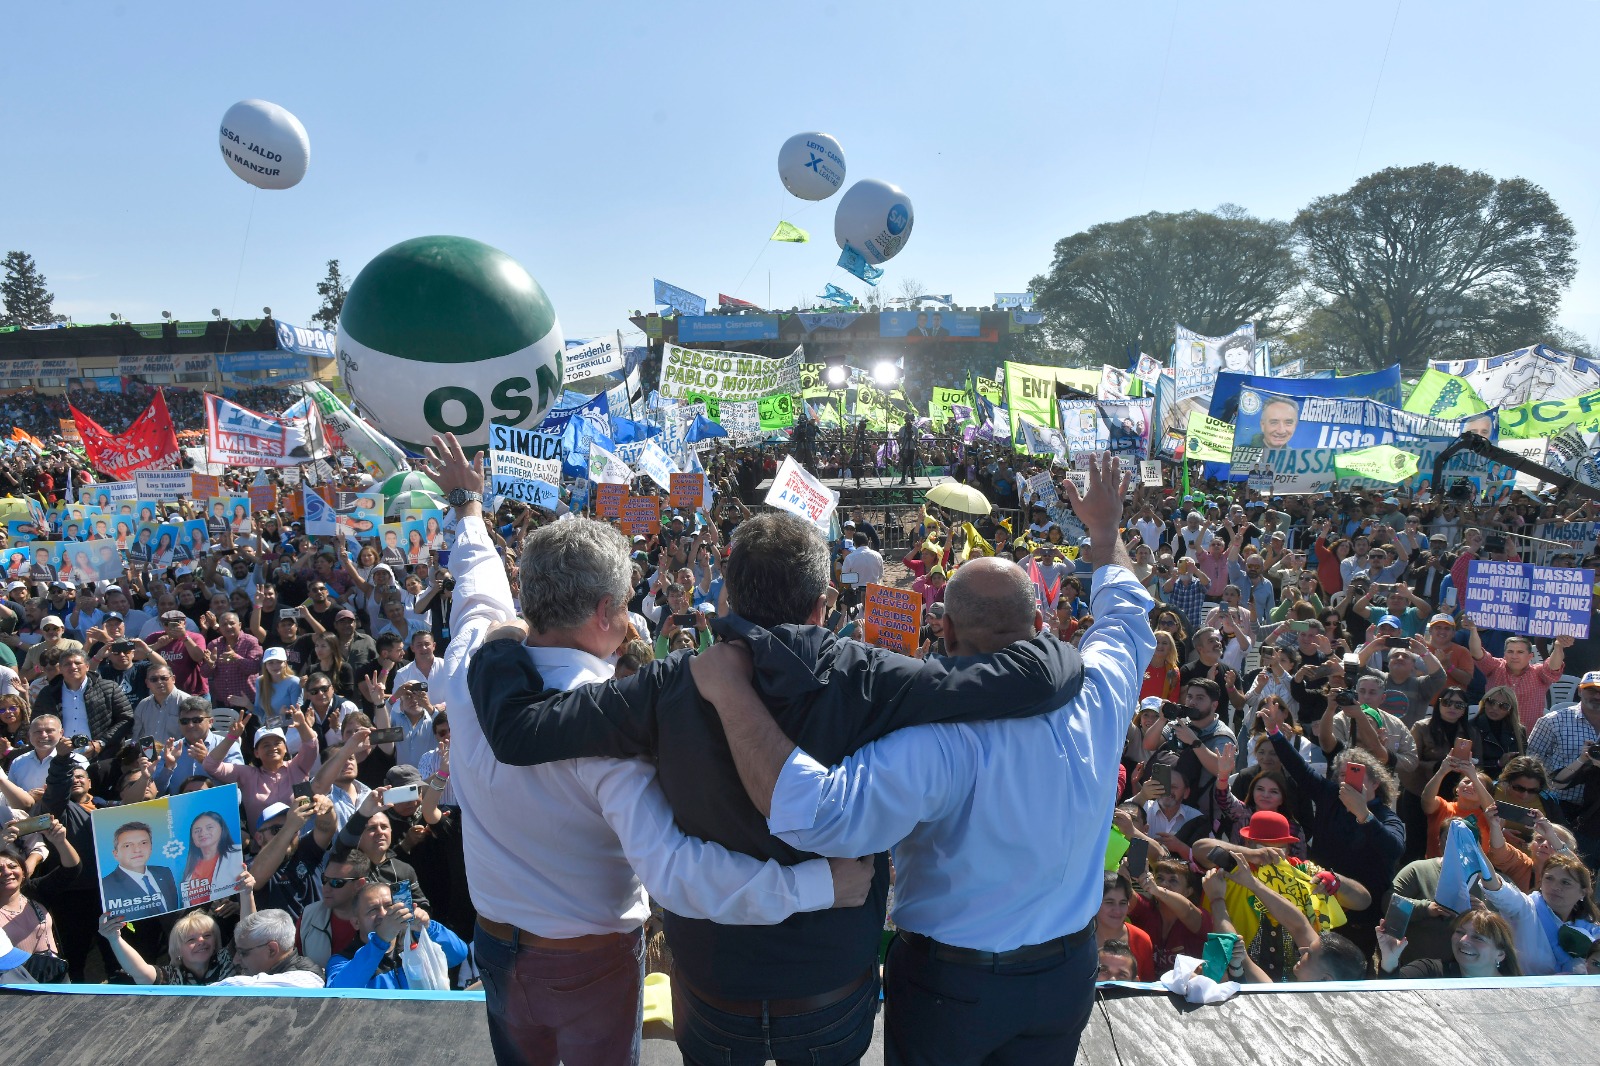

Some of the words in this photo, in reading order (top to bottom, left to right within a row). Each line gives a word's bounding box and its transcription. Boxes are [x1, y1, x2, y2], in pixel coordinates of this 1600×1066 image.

[247, 143, 283, 162] JALDO
[806, 140, 825, 153] LEITO
[234, 154, 281, 176] MANZUR
[804, 152, 824, 172] X
[889, 209, 907, 229] SAT
[693, 321, 722, 330] Massa
[725, 320, 764, 330] Cisneros
[12, 360, 35, 369] GLADYS
[146, 355, 172, 363] GLADYS
[669, 346, 733, 374] SERGIO
[736, 358, 785, 378] MASSA
[143, 363, 175, 373] MEDINA
[566, 369, 592, 381] TORO
[664, 364, 719, 389] PABLO
[721, 372, 778, 392] MOYANO
[1300, 398, 1364, 426] AGRUPACION
[494, 426, 563, 462] SIMOCA
[1317, 425, 1376, 449] Lista
[226, 454, 277, 466] TUCUMAN
[496, 454, 533, 469] MARCELO
[1267, 448, 1337, 475] MASSA
[497, 465, 532, 479] HERRERA
[111, 493, 137, 501] Talitas
[1543, 523, 1587, 541] MASSA
[1477, 563, 1524, 577] MASSA
[1533, 569, 1583, 583] MASSA
[1469, 577, 1489, 585] GLADYS
[1489, 576, 1530, 590] MEDINA
[1545, 582, 1591, 597] MEDINA
[878, 588, 909, 600] JALDO
[1467, 588, 1494, 602] JALDO
[1501, 590, 1530, 604] FUNEZ
[870, 595, 917, 612] ACEVEDO
[1481, 603, 1513, 615] APOYA:
[1530, 595, 1550, 609] LDO
[1557, 597, 1591, 612] FUNEZ
[872, 607, 913, 624] ALCIDES
[1467, 612, 1495, 629] SERGIO
[1497, 615, 1528, 632] MURAY
[1534, 610, 1571, 621] APOYA:
[868, 615, 916, 634] SALOMON
[1528, 619, 1551, 636] RGIO
[1553, 622, 1588, 638] MURAY
[878, 629, 903, 641] LOLA
[877, 637, 903, 651] SILVA
[180, 877, 210, 892] Elia
[108, 891, 163, 910] Massa
[109, 900, 162, 917] presidente
